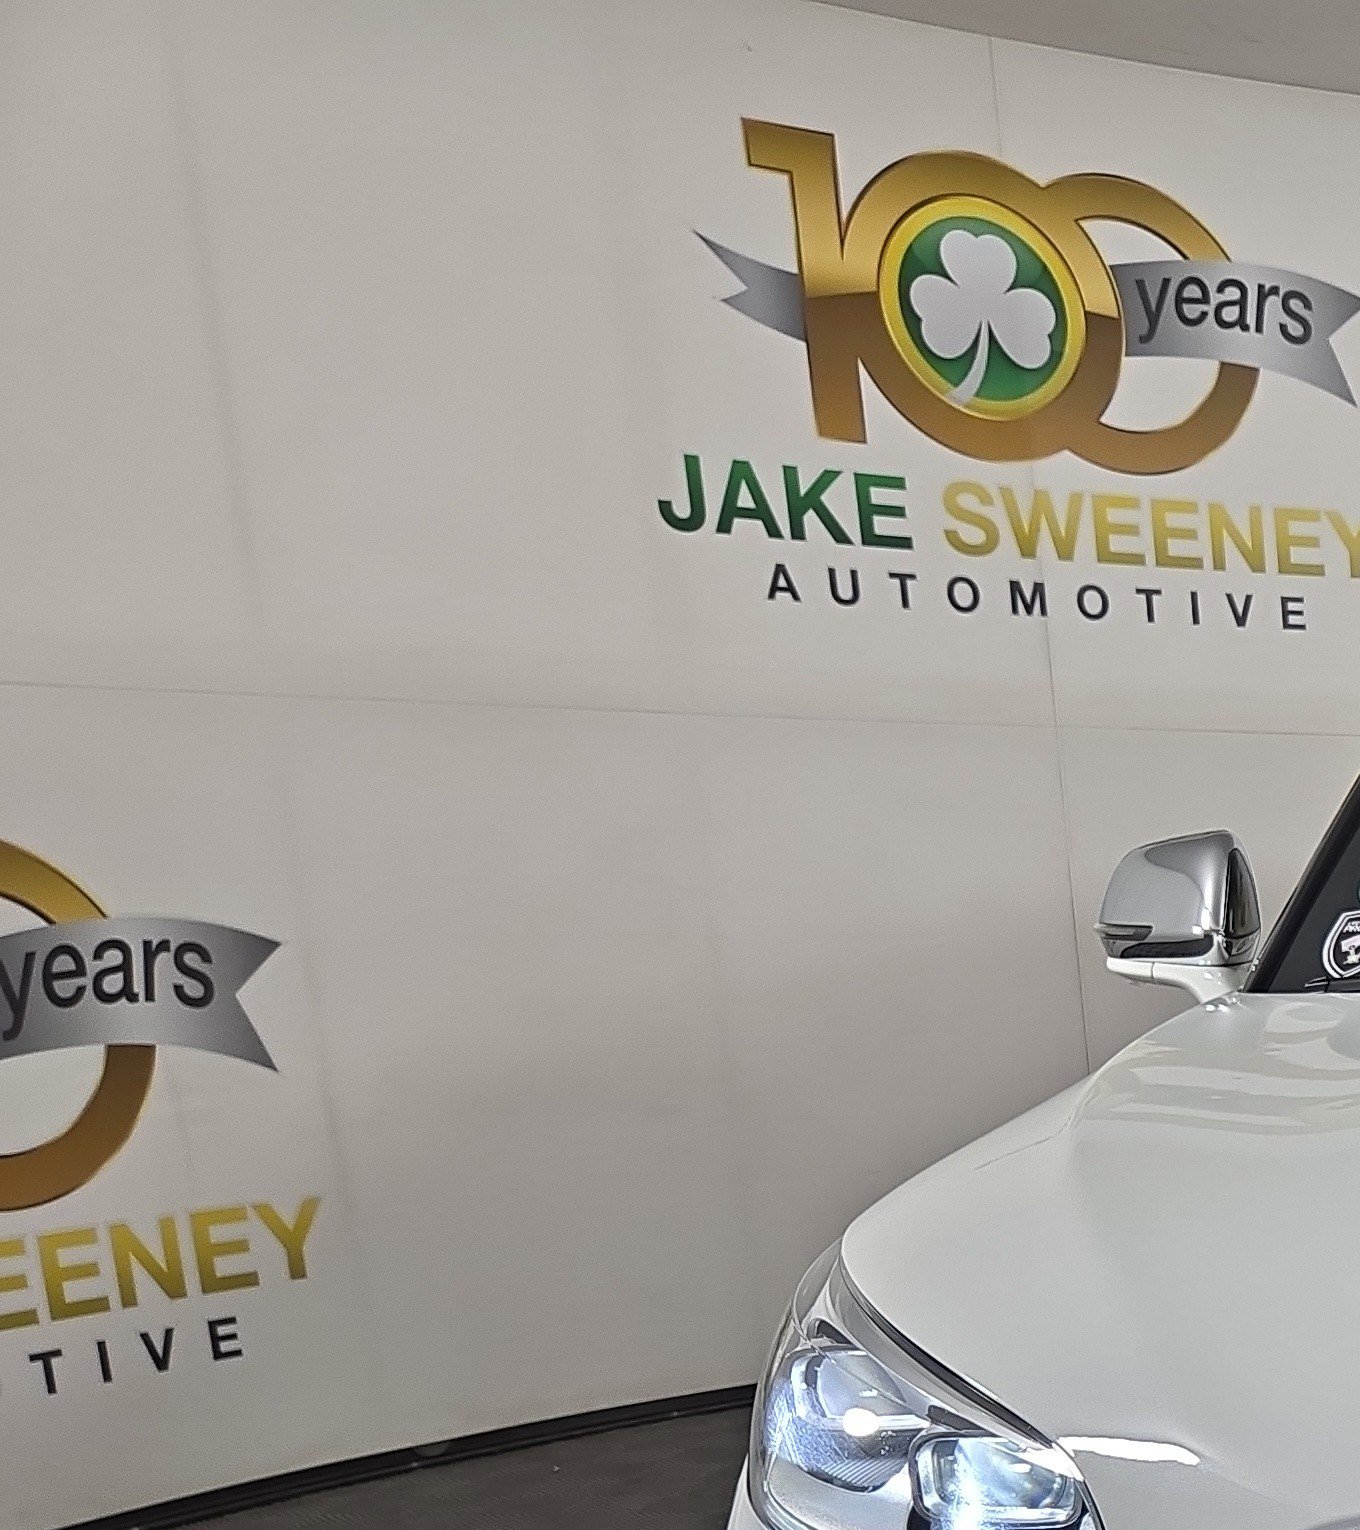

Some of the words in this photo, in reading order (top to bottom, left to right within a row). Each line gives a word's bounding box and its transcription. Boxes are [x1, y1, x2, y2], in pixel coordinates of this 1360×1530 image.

[741, 117, 1261, 477] 100
[1134, 274, 1315, 344] years
[656, 454, 913, 552] JAKE
[767, 563, 1307, 631] AUTOMOTIVE
[0, 936, 215, 1041] years
